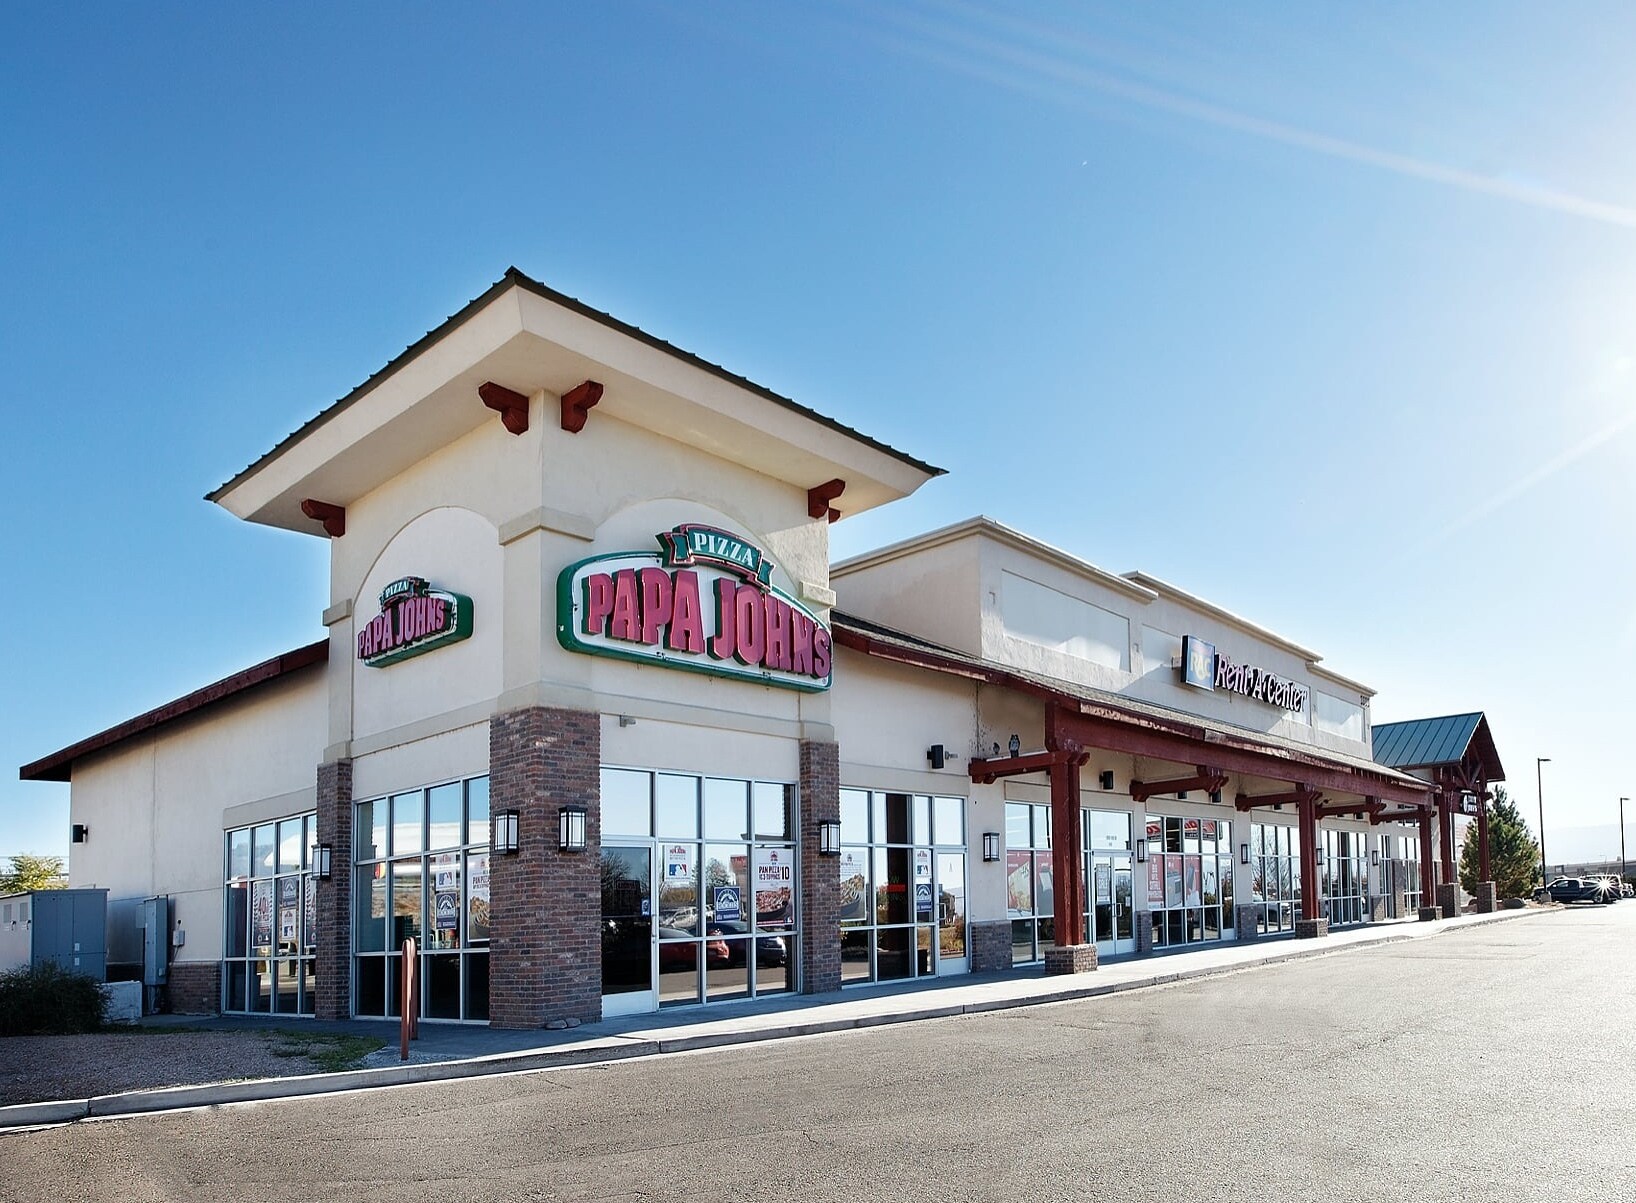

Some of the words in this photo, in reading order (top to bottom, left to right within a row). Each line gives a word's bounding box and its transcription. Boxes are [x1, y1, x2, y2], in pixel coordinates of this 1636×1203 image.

[694, 532, 754, 568] PIZZA
[385, 580, 409, 598] PIZZA
[584, 567, 705, 654] PAPA
[358, 607, 393, 658] PAPA
[1190, 650, 1212, 681] RAC
